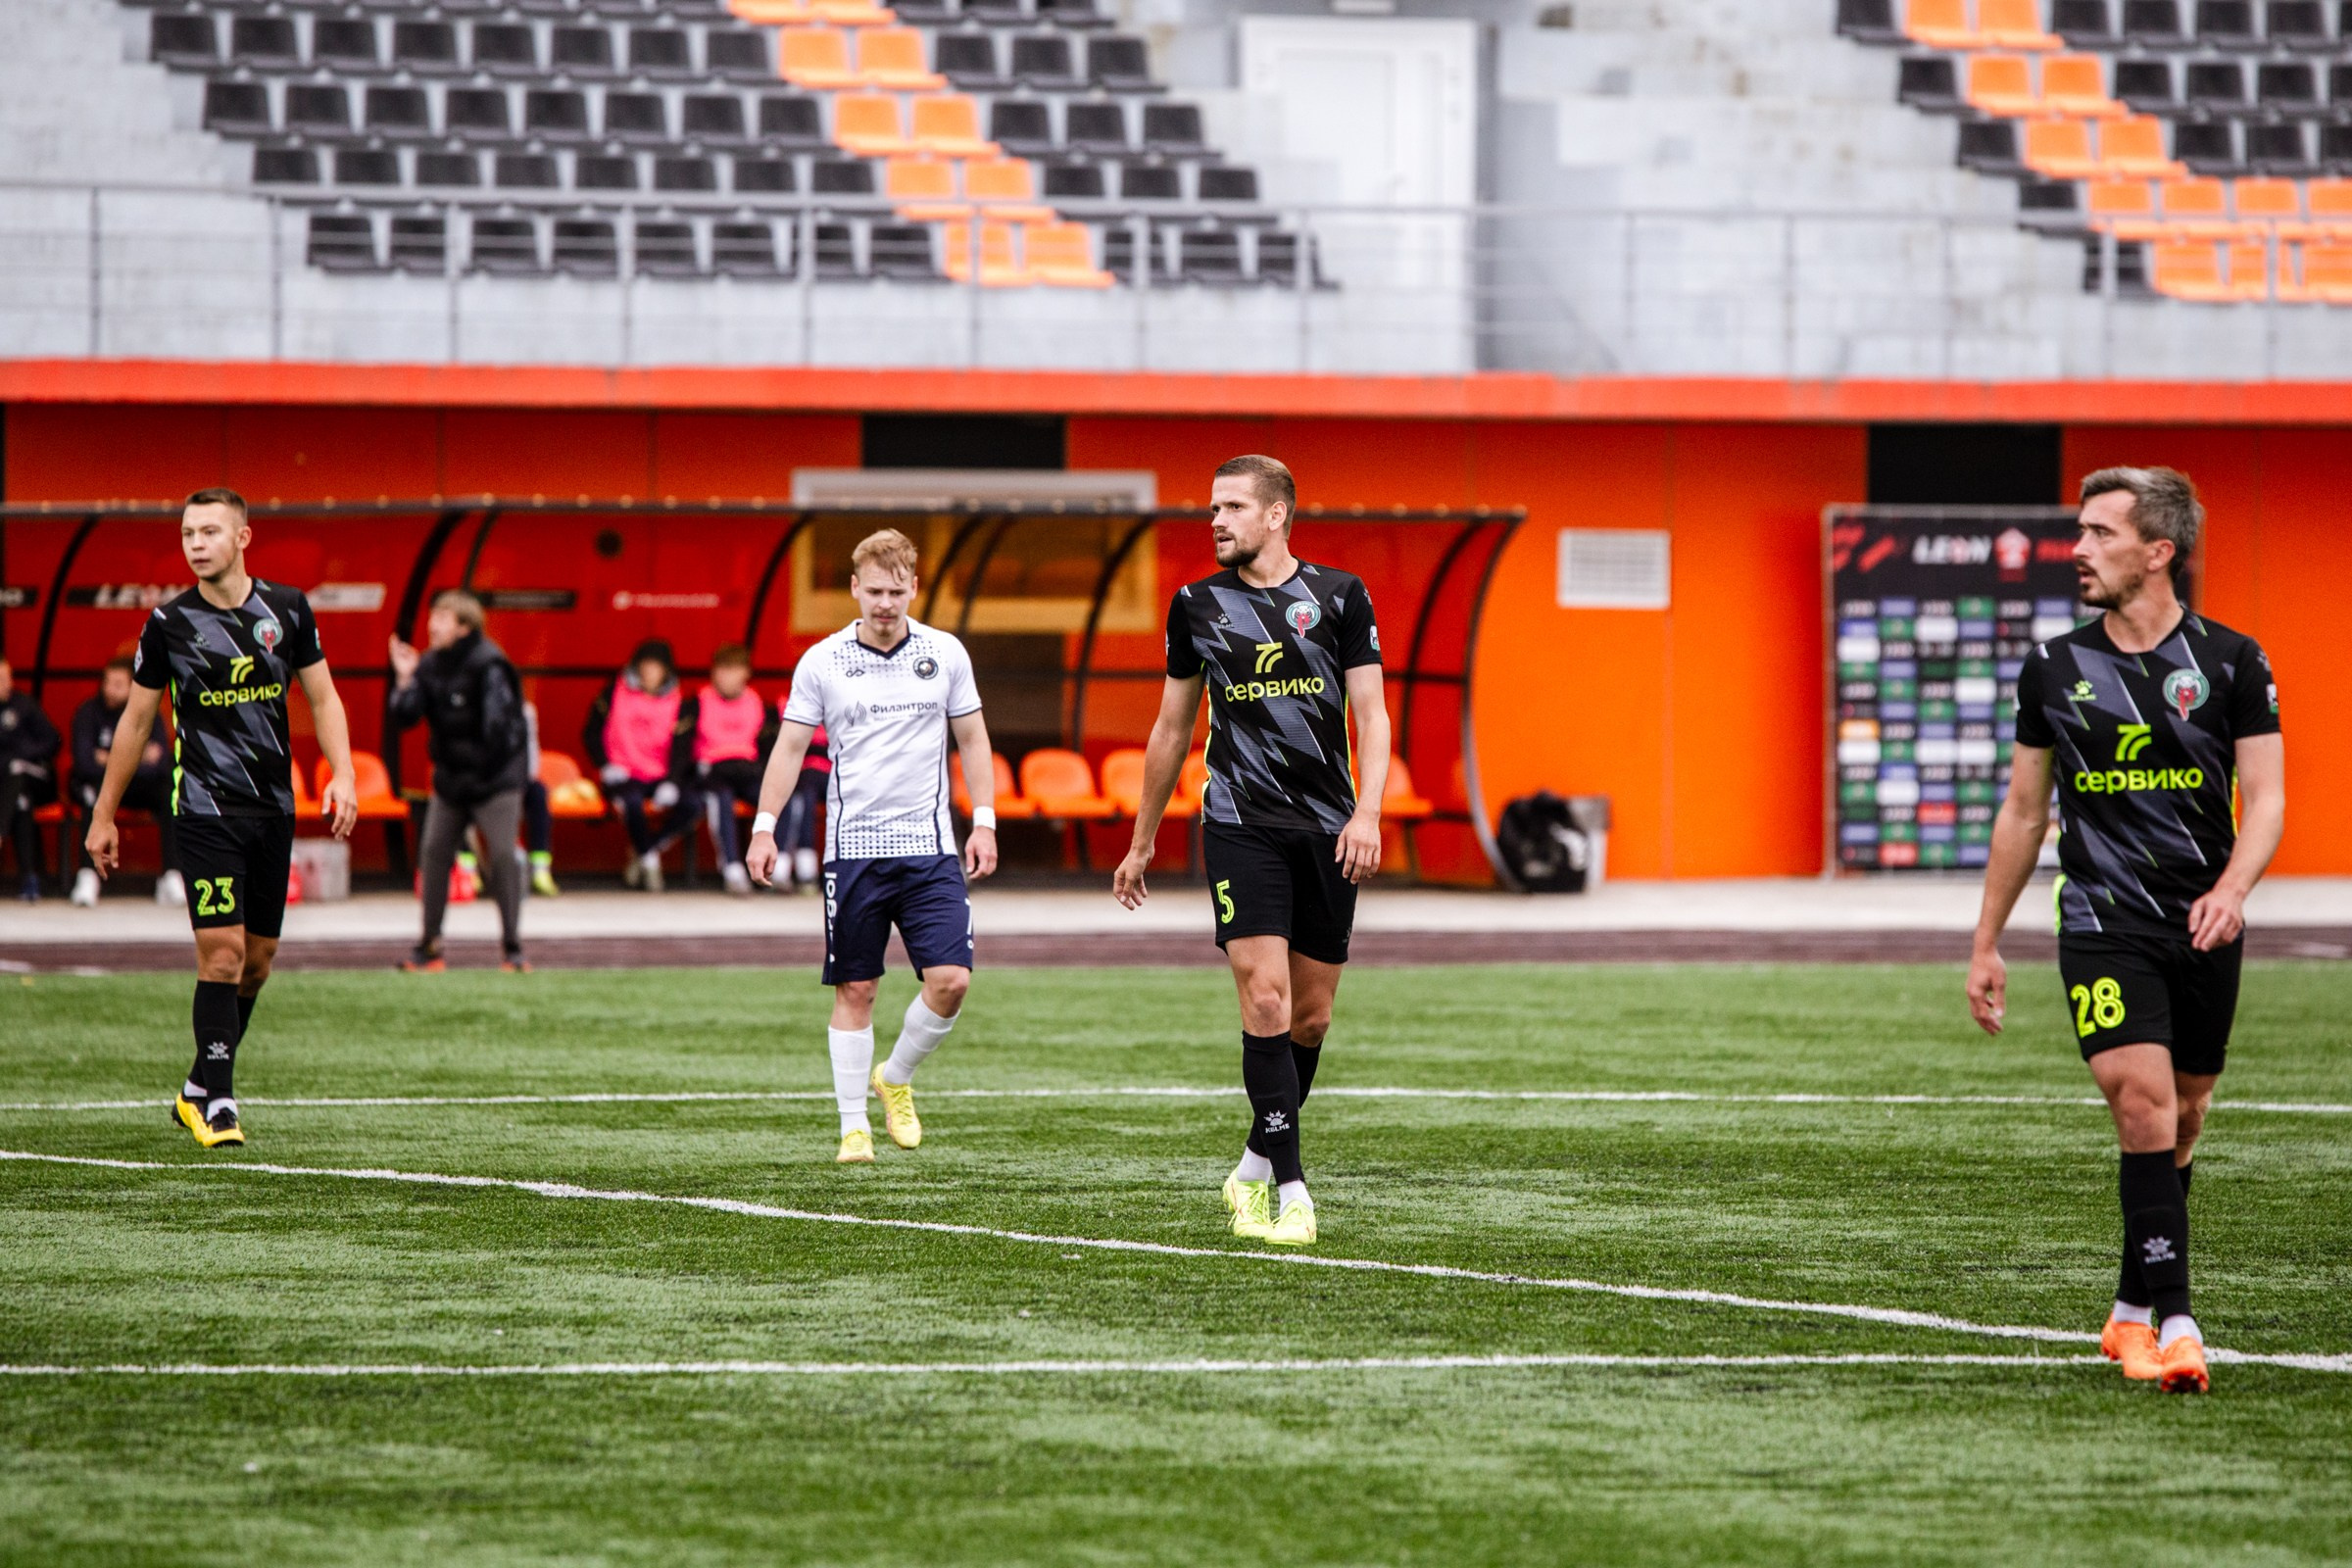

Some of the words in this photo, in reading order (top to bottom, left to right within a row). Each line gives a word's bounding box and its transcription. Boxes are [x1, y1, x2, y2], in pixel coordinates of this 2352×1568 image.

[199, 682, 282, 708] сервико
[1225, 676, 1325, 703] сервико
[869, 701, 938, 714] Филантроп
[2075, 767, 2204, 795] сервико
[194, 876, 236, 916] 23
[1216, 879, 1235, 924] 5
[2070, 976, 2127, 1039] 28
[1264, 1122, 1291, 1134] KELME
